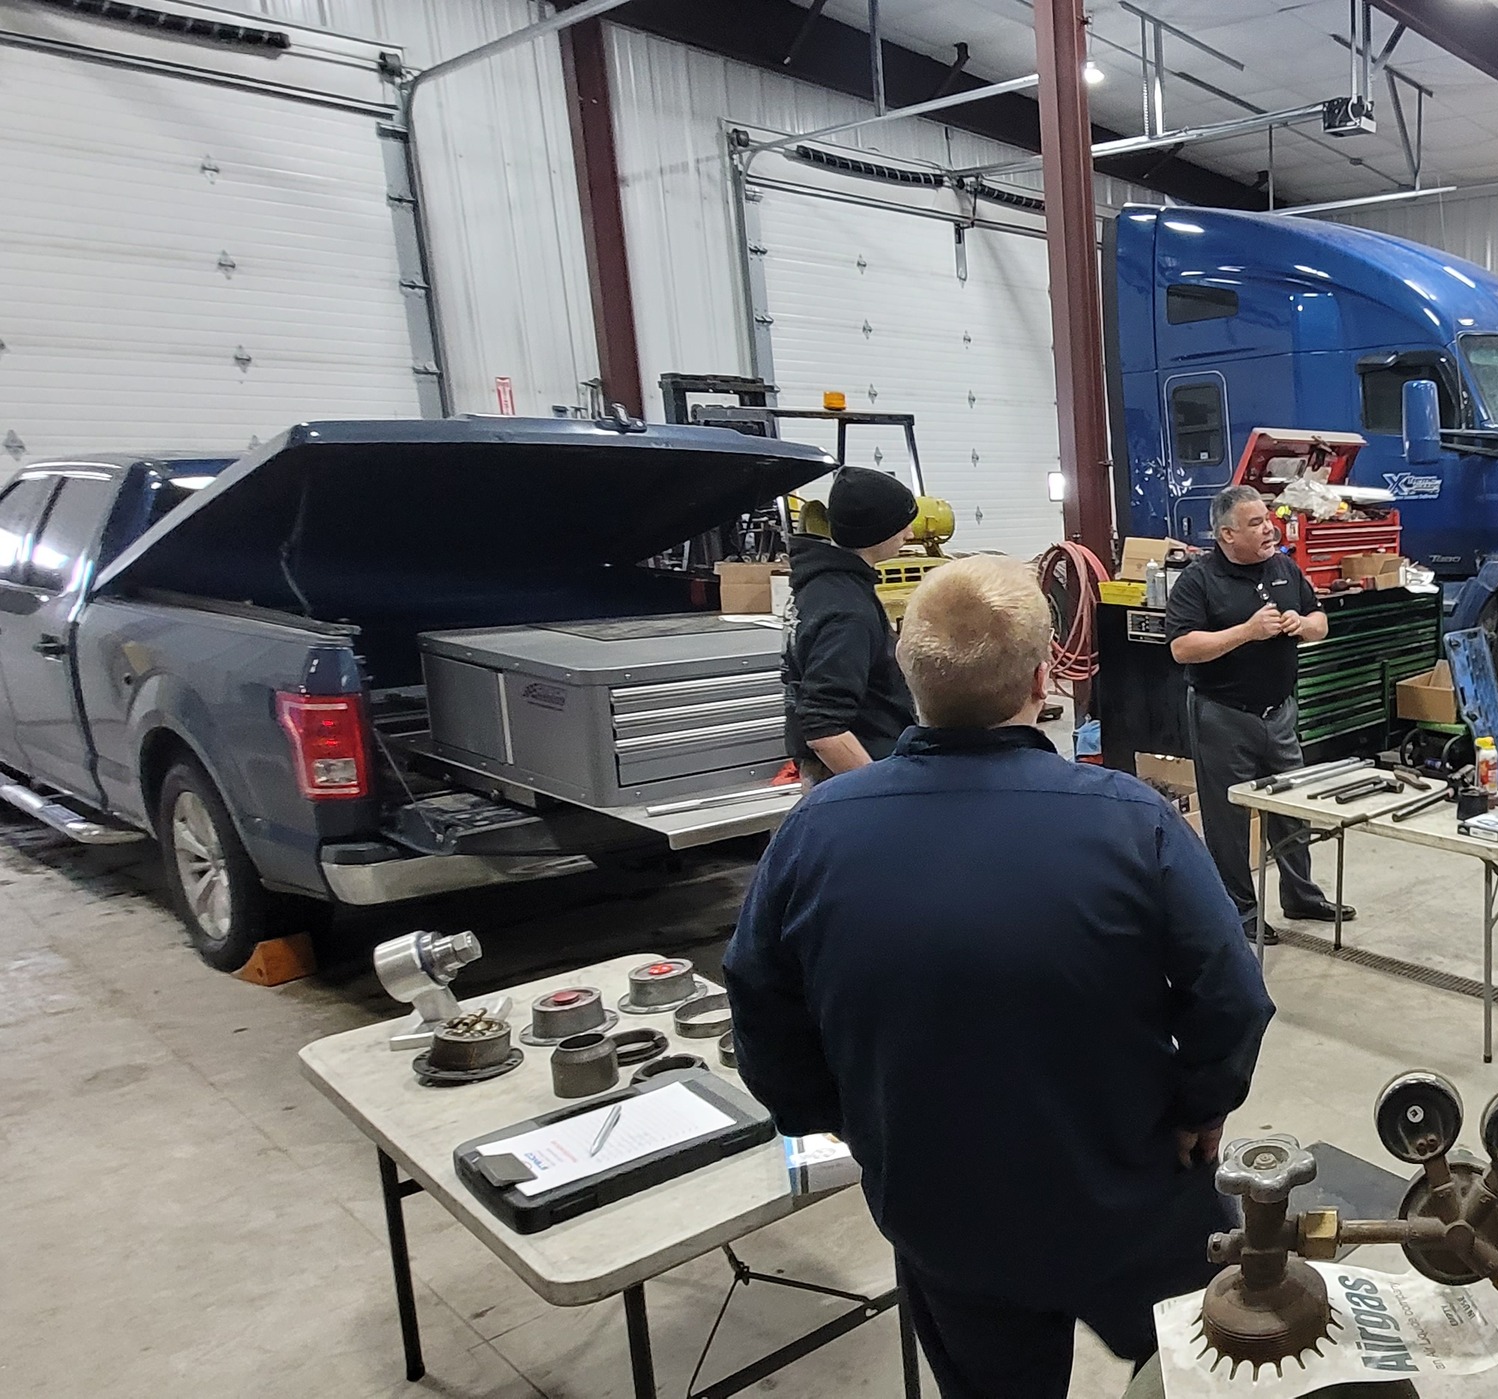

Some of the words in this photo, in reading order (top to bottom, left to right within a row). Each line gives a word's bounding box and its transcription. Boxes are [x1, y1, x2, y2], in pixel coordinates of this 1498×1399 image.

[1338, 1275, 1420, 1372] Airgas
[1423, 1347, 1438, 1361] Air
[1432, 1359, 1446, 1370] an
